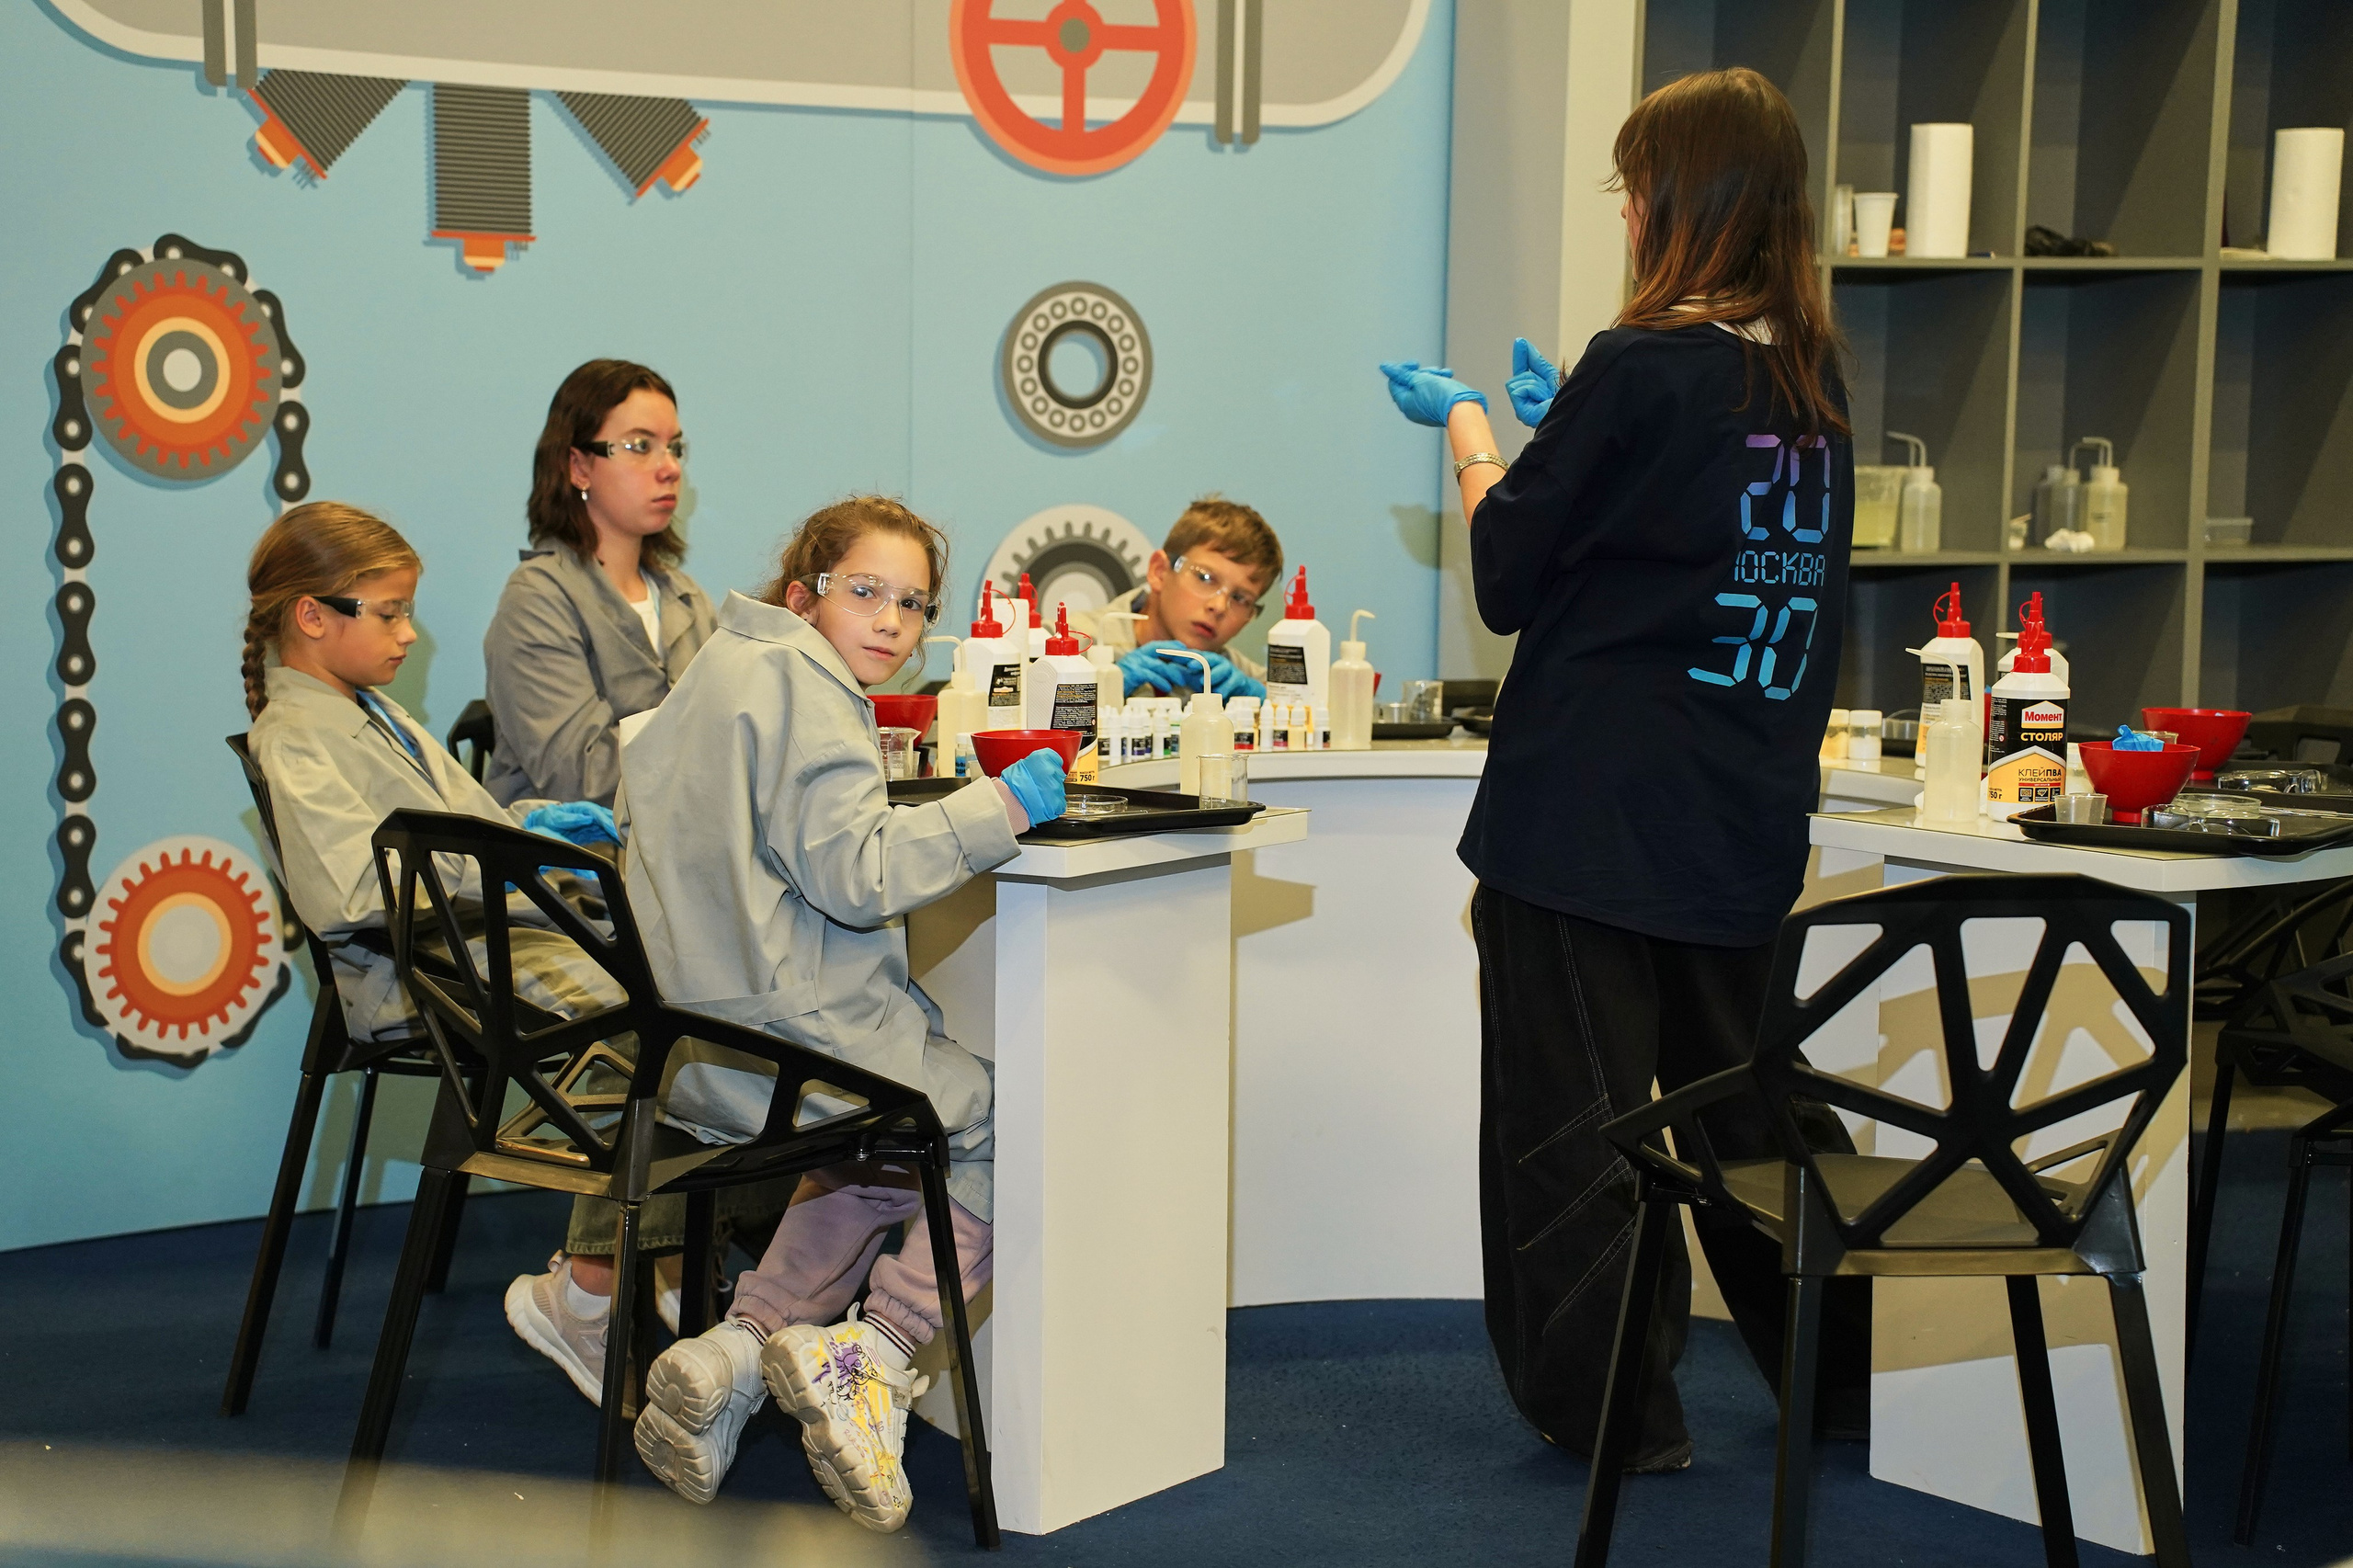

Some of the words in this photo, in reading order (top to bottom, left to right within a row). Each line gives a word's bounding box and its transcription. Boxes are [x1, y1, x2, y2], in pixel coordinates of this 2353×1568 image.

[1740, 434, 1830, 543] 20
[1688, 593, 1818, 701] 30
[2024, 711, 2063, 722] Момент
[2020, 733, 2063, 742] СТОЛЯР
[1079, 774, 1092, 782] 750
[1988, 790, 1998, 800] 50
